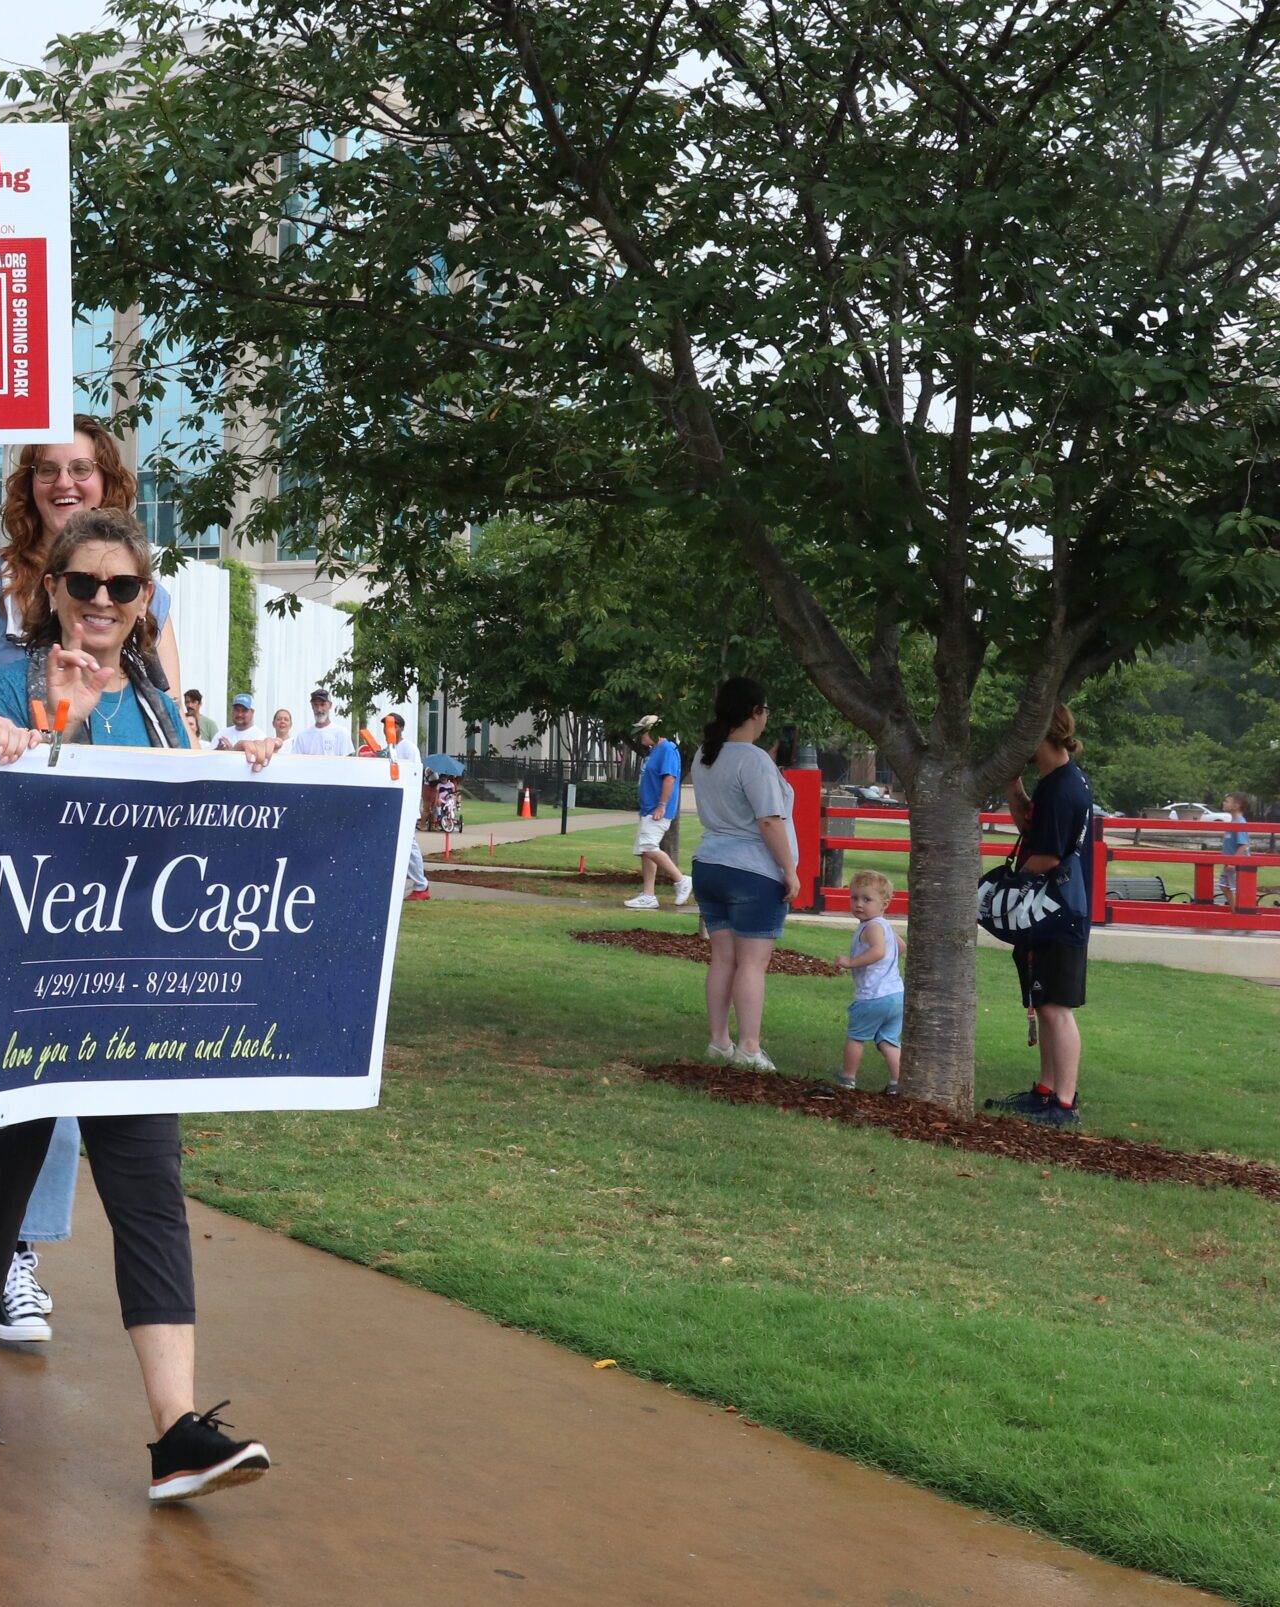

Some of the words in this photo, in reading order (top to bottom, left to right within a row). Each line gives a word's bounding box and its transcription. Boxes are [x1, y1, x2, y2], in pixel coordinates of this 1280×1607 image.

[11, 269, 27, 294] BIG
[12, 298, 28, 355] SPRING
[13, 360, 29, 398] PARK
[59, 801, 91, 825] IN
[93, 803, 182, 828] LOVING
[185, 804, 288, 830] MEMORY
[150, 854, 316, 952] Cagle
[33, 972, 126, 999] 4/29/1994
[146, 971, 243, 996] 8/24/2019
[2, 1031, 33, 1069] love
[33, 1042, 69, 1080] you
[78, 1032, 97, 1061] to
[105, 1026, 136, 1060] the
[145, 1042, 187, 1061] moon
[194, 1025, 231, 1060] and
[231, 1022, 291, 1062] back...
